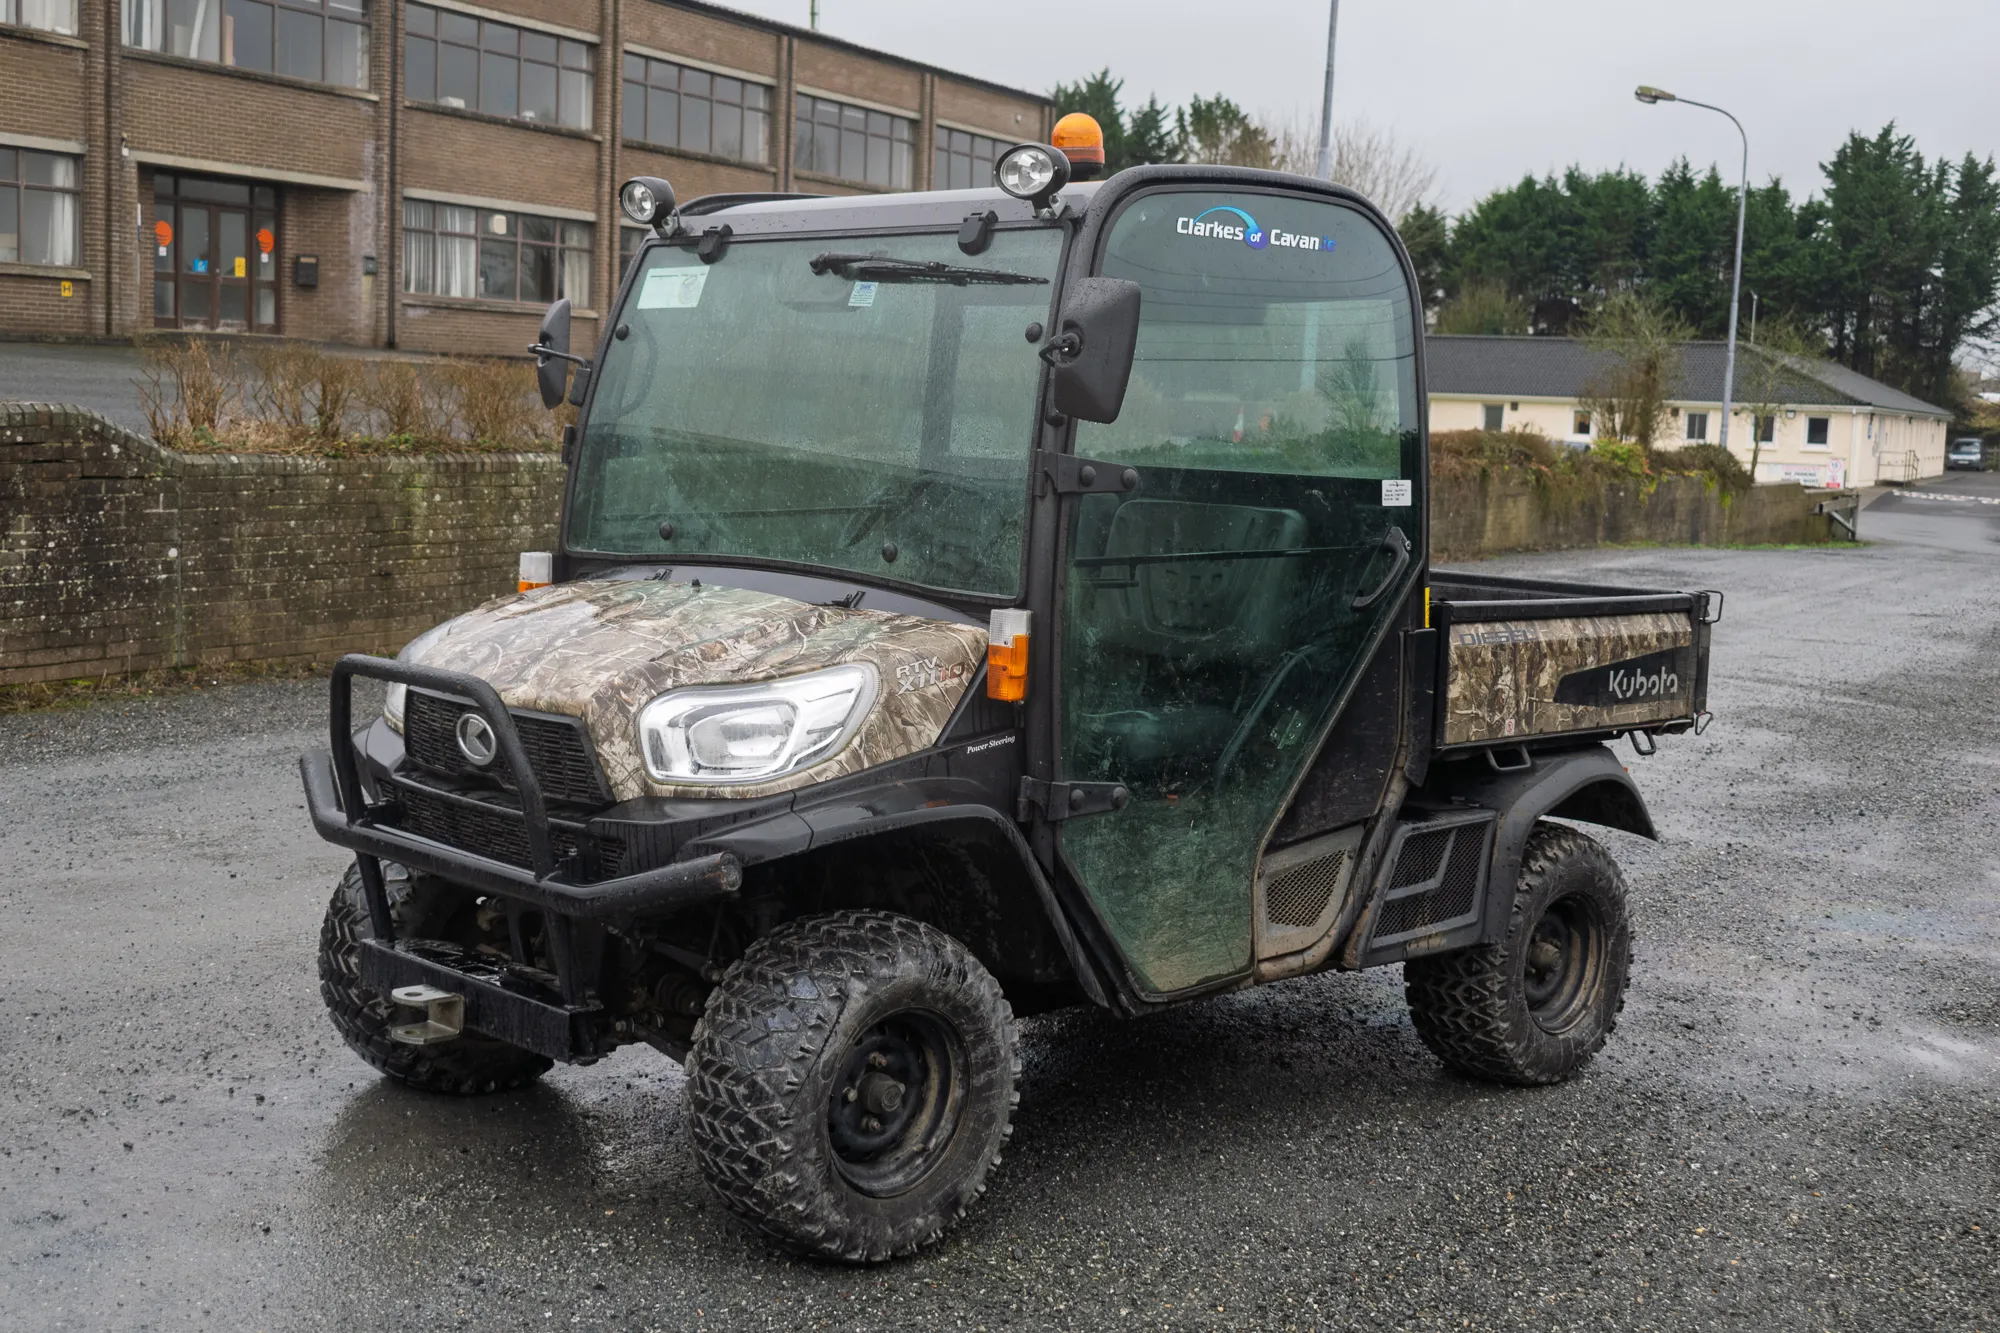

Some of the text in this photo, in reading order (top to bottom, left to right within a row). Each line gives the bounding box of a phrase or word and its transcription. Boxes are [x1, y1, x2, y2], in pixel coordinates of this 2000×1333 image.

[1177, 216, 1244, 241] Clarkes
[1250, 232, 1262, 243] of
[896, 656, 937, 679] RTV
[897, 661, 966, 696] X1110
[1609, 666, 1678, 699] Kubota
[967, 735, 1016, 754] Power Steering
